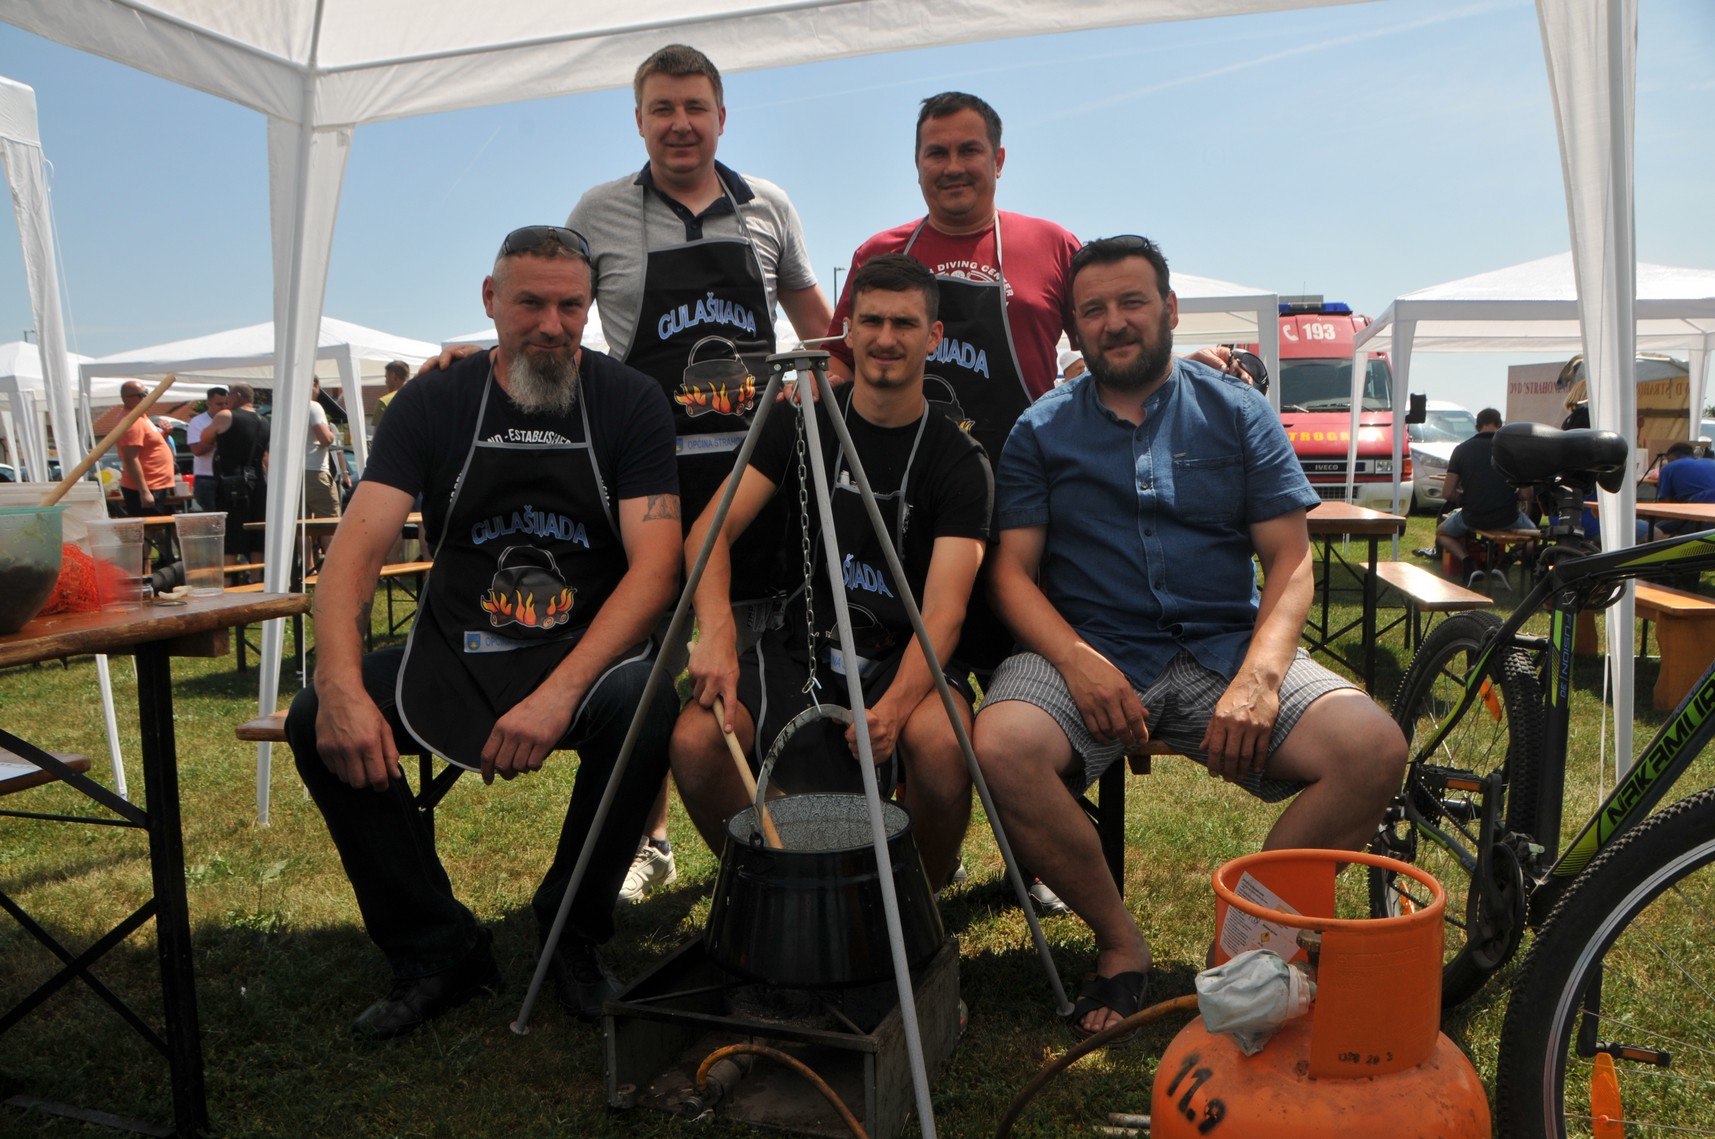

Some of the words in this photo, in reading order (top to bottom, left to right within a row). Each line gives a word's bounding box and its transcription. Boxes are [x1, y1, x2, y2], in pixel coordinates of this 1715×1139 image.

[937, 261, 978, 271] DIVING
[981, 265, 1014, 297] CENER
[658, 292, 757, 340] GULAŠIJADA
[1303, 323, 1336, 340] 193
[471, 505, 590, 549] GULAŠIJADA
[1561, 613, 1572, 675] FUSION
